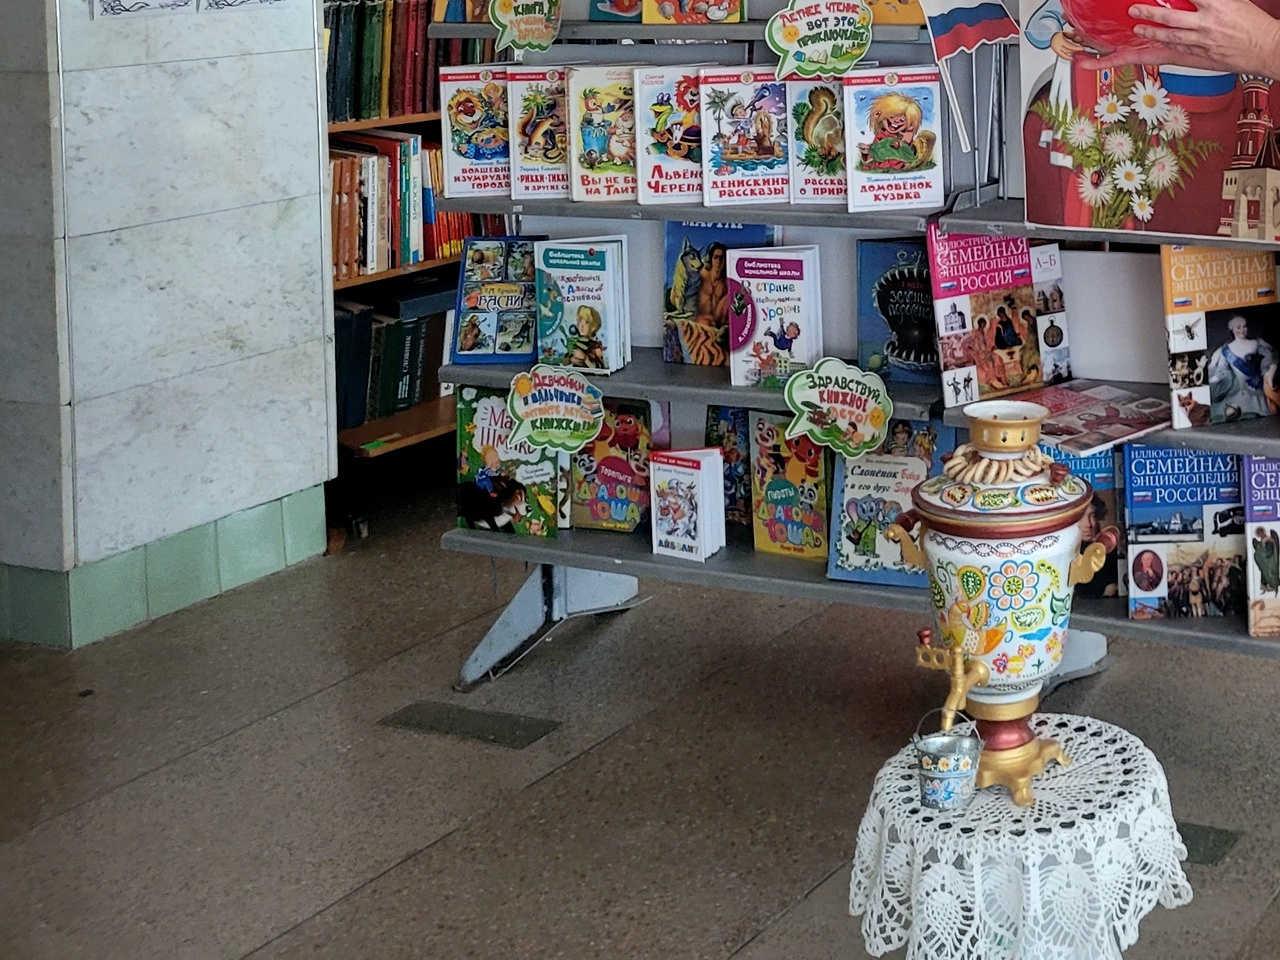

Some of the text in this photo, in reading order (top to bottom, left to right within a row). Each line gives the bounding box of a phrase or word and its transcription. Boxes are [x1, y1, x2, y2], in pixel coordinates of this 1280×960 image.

[779, 2, 860, 28] ЛЕТНЕЕ ЧТЕНИЕ
[806, 16, 854, 31] ВОТ ЭТО
[605, 176, 619, 184] НЕ
[860, 181, 932, 193] ДОМОВЁНОК
[585, 187, 600, 195] НА
[873, 191, 921, 202] КУЗЬКА
[937, 237, 1028, 268] СЕМЕЙНАЯ
[939, 253, 1029, 278] ЭНЦИКЛОПЕДИЯ
[1171, 253, 1274, 281] СЕМЕЙНАЯ
[960, 269, 1012, 291] РОССИЯ
[1173, 272, 1275, 292] ЭНЦИКЛОПЕДИЯ
[478, 294, 524, 312] БАСНИ
[1195, 289, 1255, 308] РОССИЯ
[806, 373, 882, 405] ЗДРАВСТВУЙ,
[818, 389, 869, 412] КНИЖНОЕ
[1131, 455, 1238, 475] СЕМЕЙНАЯ
[1132, 472, 1239, 487] ЭНЦИКЛОПЕДИЯ
[1156, 487, 1217, 503] РОССИЯ
